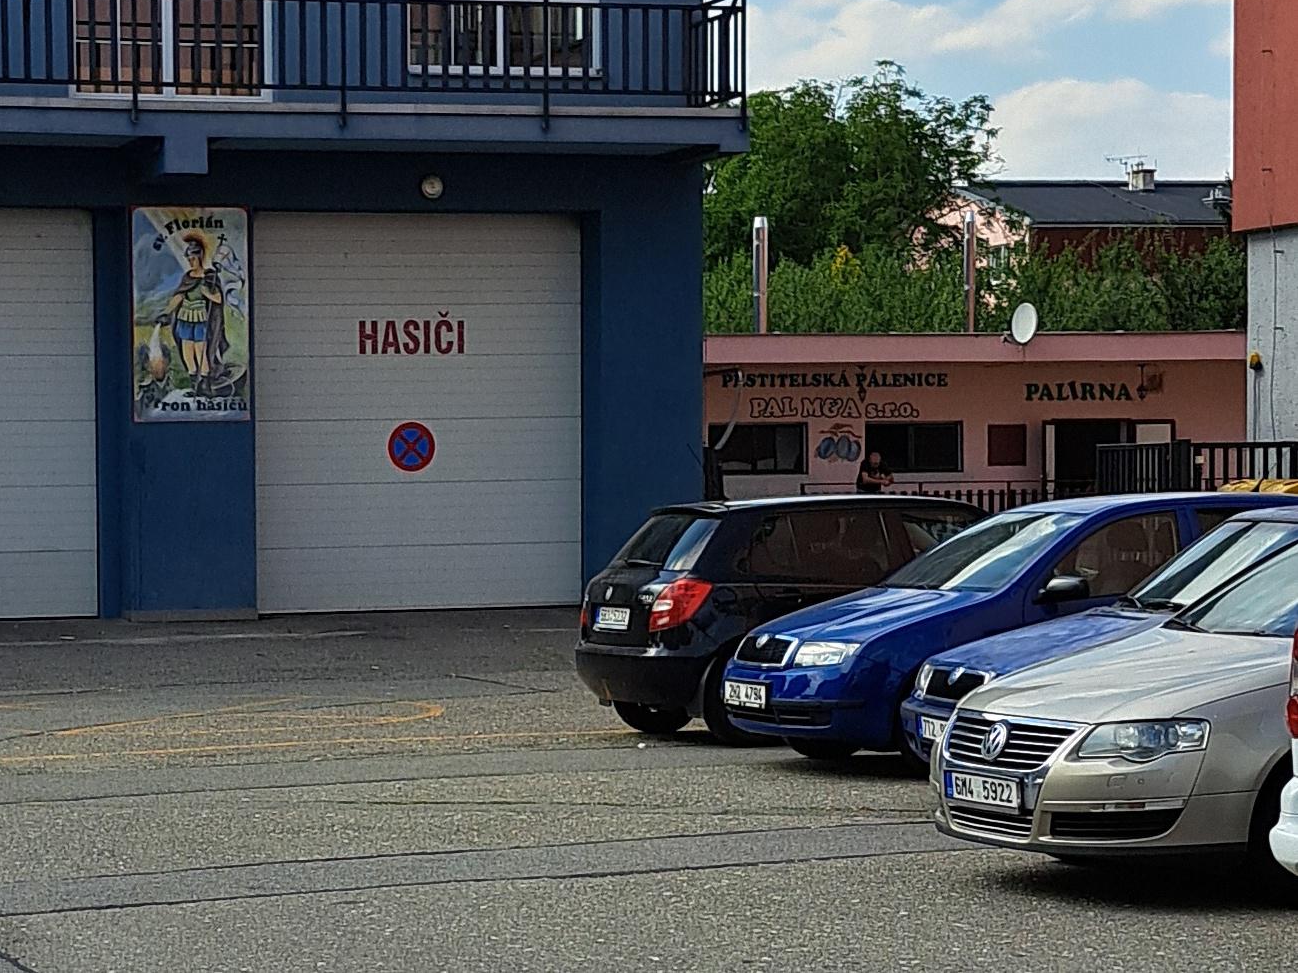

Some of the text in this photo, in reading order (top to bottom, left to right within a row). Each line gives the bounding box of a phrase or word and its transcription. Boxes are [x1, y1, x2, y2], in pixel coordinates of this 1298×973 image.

[164, 215, 224, 235] Florián
[358, 311, 465, 355] HASIČI
[855, 370, 949, 388] PÁLENICE
[750, 396, 798, 418] PAL
[954, 775, 1014, 804] 6M4 5922
